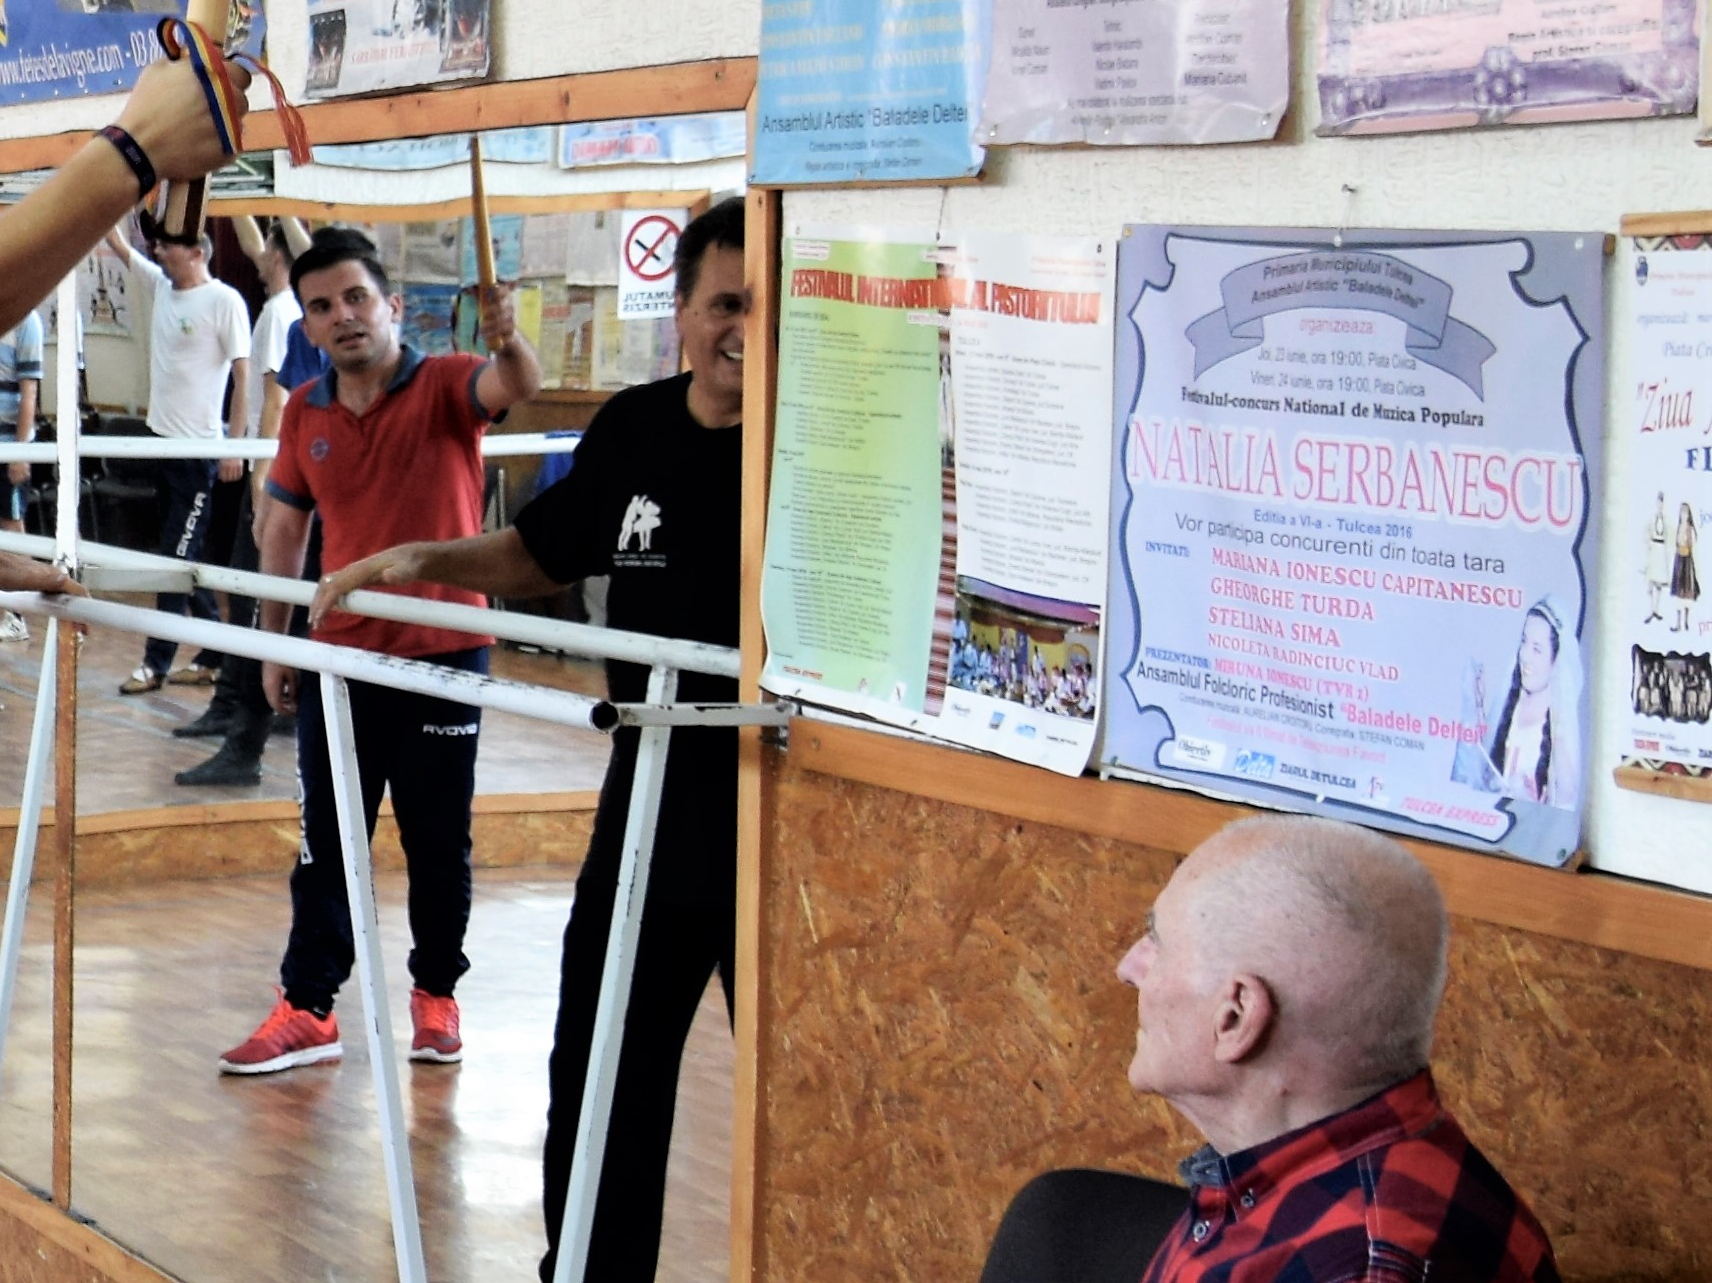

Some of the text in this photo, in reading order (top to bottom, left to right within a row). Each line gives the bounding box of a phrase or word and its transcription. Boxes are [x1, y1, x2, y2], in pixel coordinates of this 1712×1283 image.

[762, 111, 864, 133] Ansamblul Artistic
[1264, 258, 1413, 286] Primaria Municipiului Tulcea
[1251, 279, 1339, 304] Ansamblul Artistic
[1299, 318, 1373, 336] organizeaza
[1312, 352, 1327, 365] ora
[1317, 379, 1333, 391] ora
[1181, 386, 1485, 428] Festivalul-concurs National de Muzica Populara
[1128, 419, 1581, 529] NATALIA SERBANESCU
[1253, 509, 1287, 526] Editia
[1336, 518, 1381, 536] Tulcea
[1385, 524, 1413, 540] 2016
[1175, 513, 1506, 575] Vor participa concurenti din toata tara
[1211, 547, 1524, 609] MARIANA IONESCU CAPITANESCU
[1211, 577, 1375, 621] GHEORGHE TURDA
[1208, 606, 1342, 649] STELIANA SIMA
[1208, 633, 1400, 682] NICOLETA RADINCIUC VLAD
[1214, 657, 1264, 683] MIRUNA
[1137, 661, 1201, 691] Ansamblul
[1204, 675, 1257, 702] Folcloric
[1260, 685, 1334, 719] Profesionist
